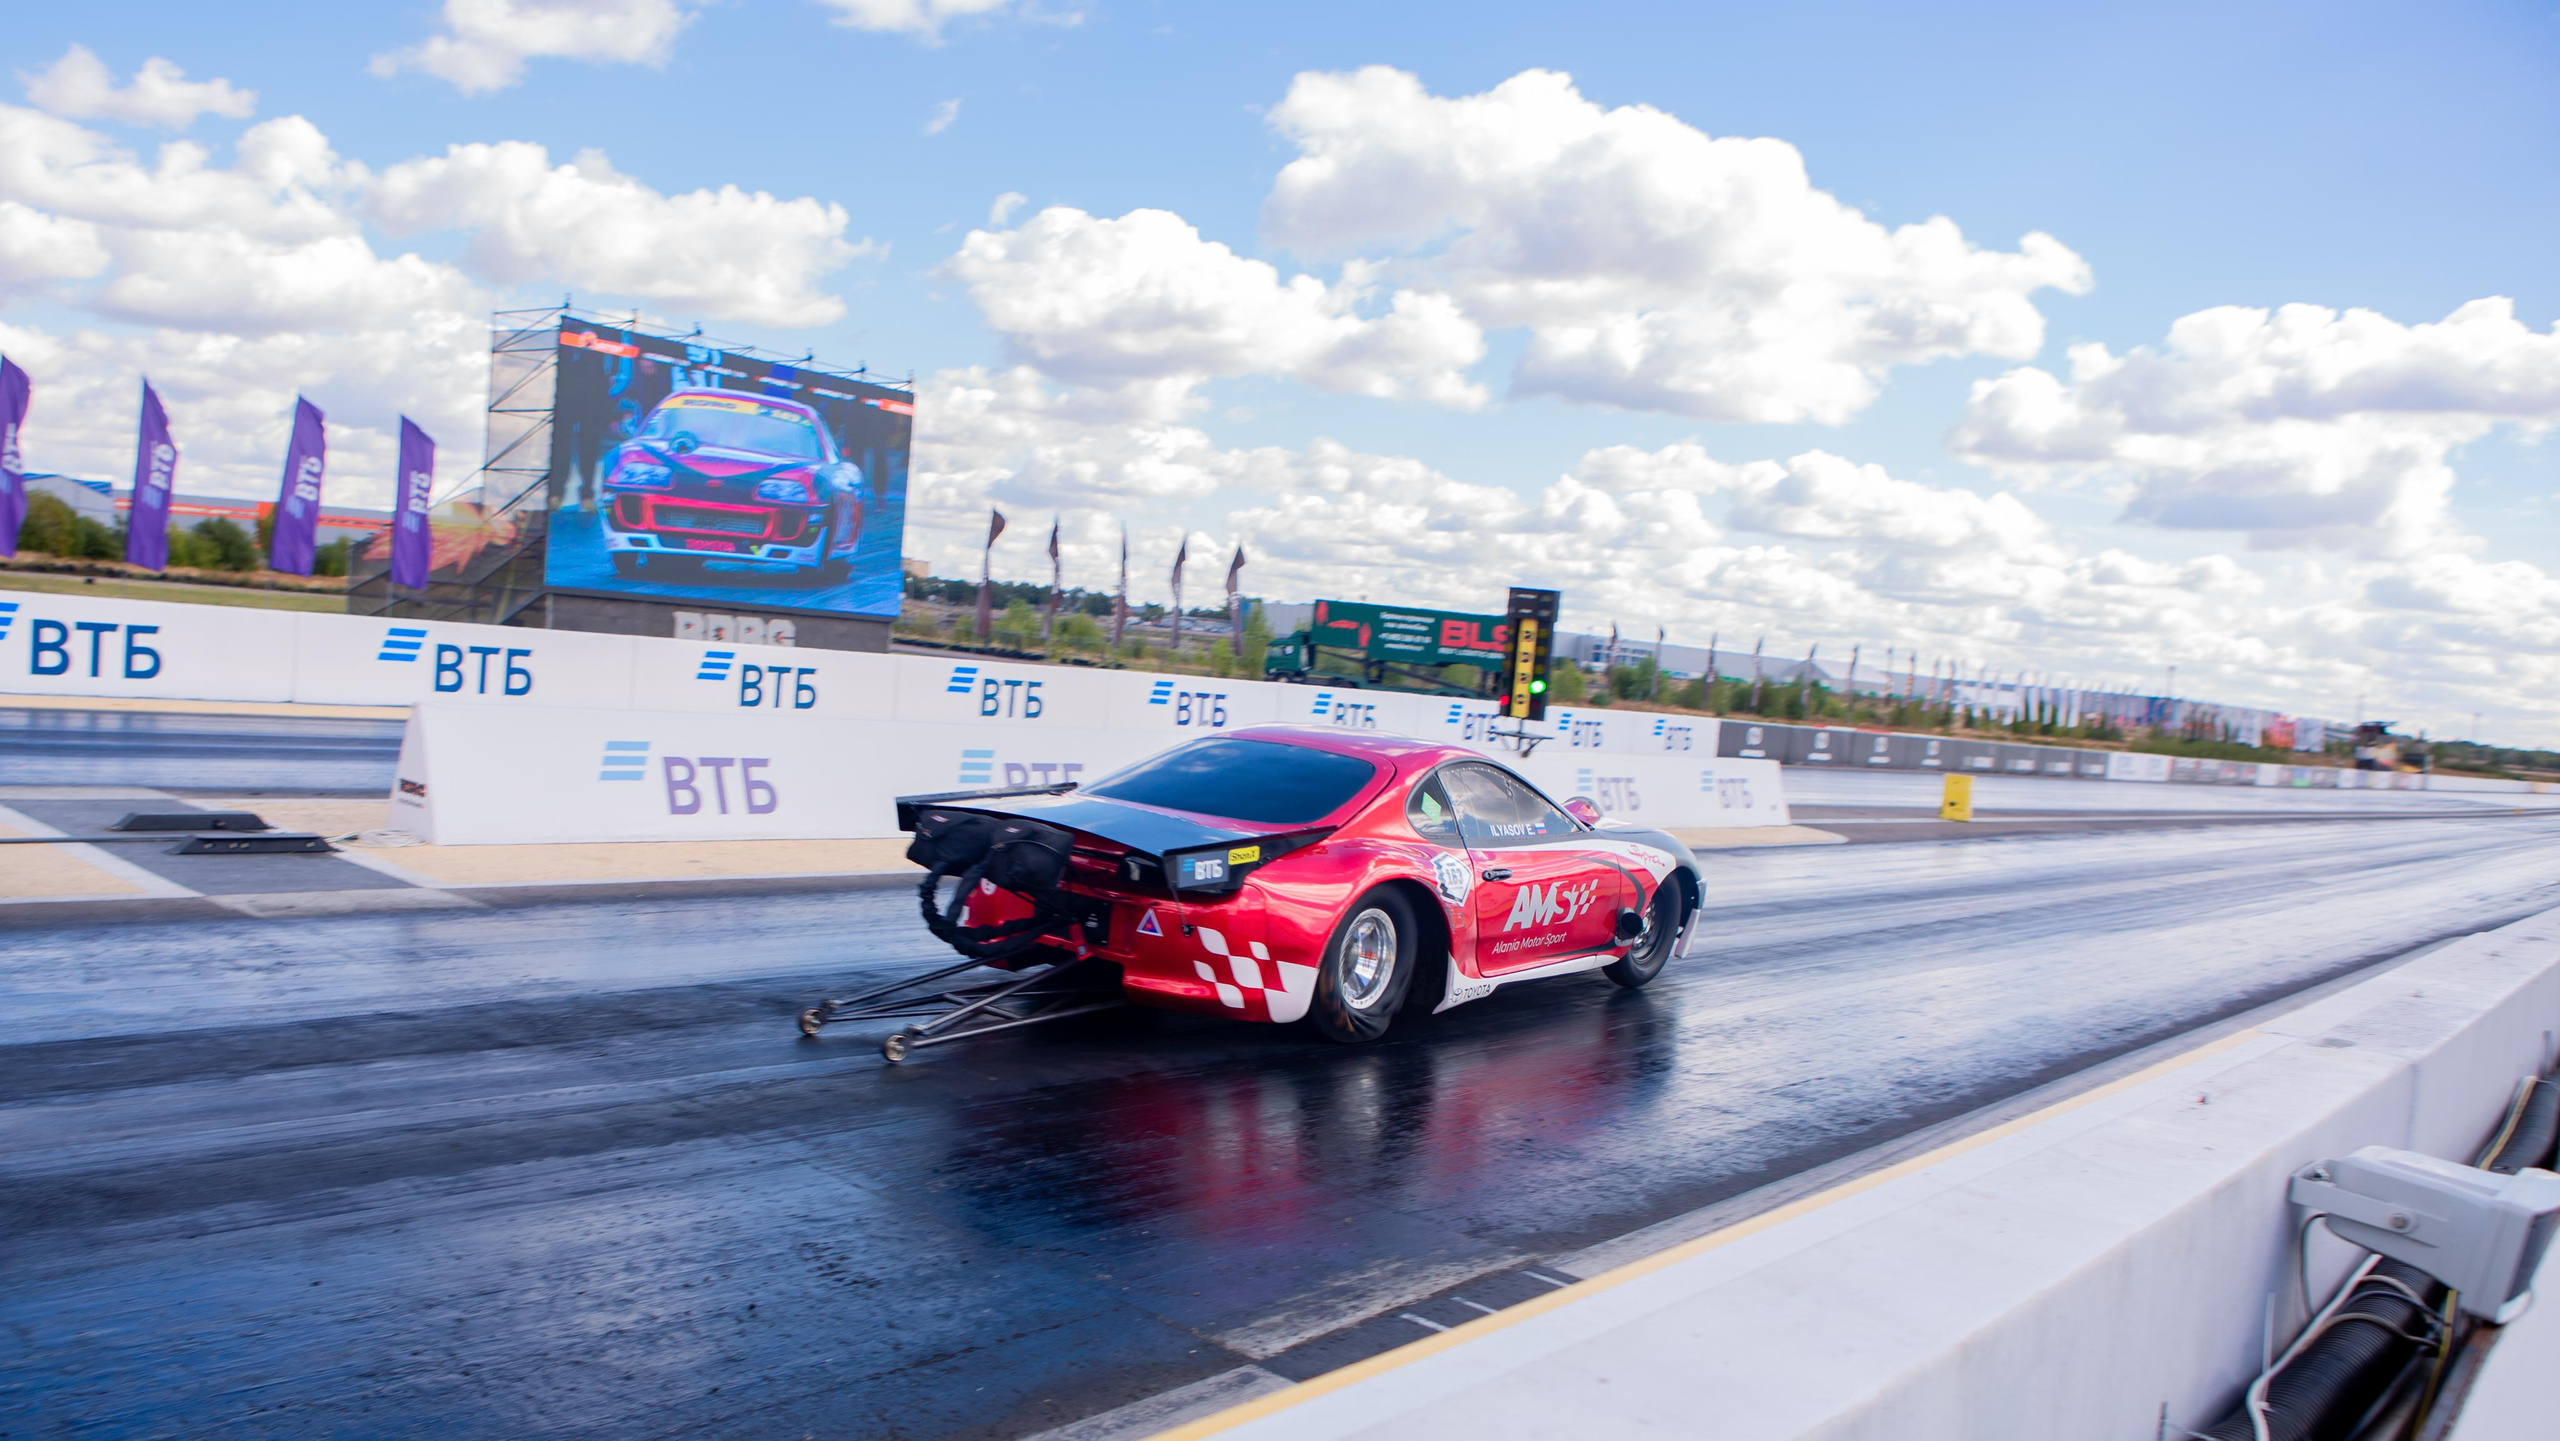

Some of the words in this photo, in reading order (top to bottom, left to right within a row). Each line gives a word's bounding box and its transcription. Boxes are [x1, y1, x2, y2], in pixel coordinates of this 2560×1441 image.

[294, 456, 323, 502] ВТБ
[408, 470, 431, 515] ВТБ
[30, 618, 162, 679] ВТБ
[434, 643, 532, 696] ВТБ
[740, 664, 818, 709] ВТБ
[981, 678, 1045, 718] ВТБ
[1177, 691, 1228, 727] ВТБ
[662, 757, 779, 815] ВТБ
[1490, 824, 1524, 836] ILYASOV
[1526, 823, 1536, 835] E.
[1194, 859, 1223, 880] ВТБ
[1492, 940, 1521, 954] Alania
[1520, 934, 1546, 950] Motor
[1546, 932, 1568, 946] Sport
[1464, 984, 1491, 999] TOYOTA
